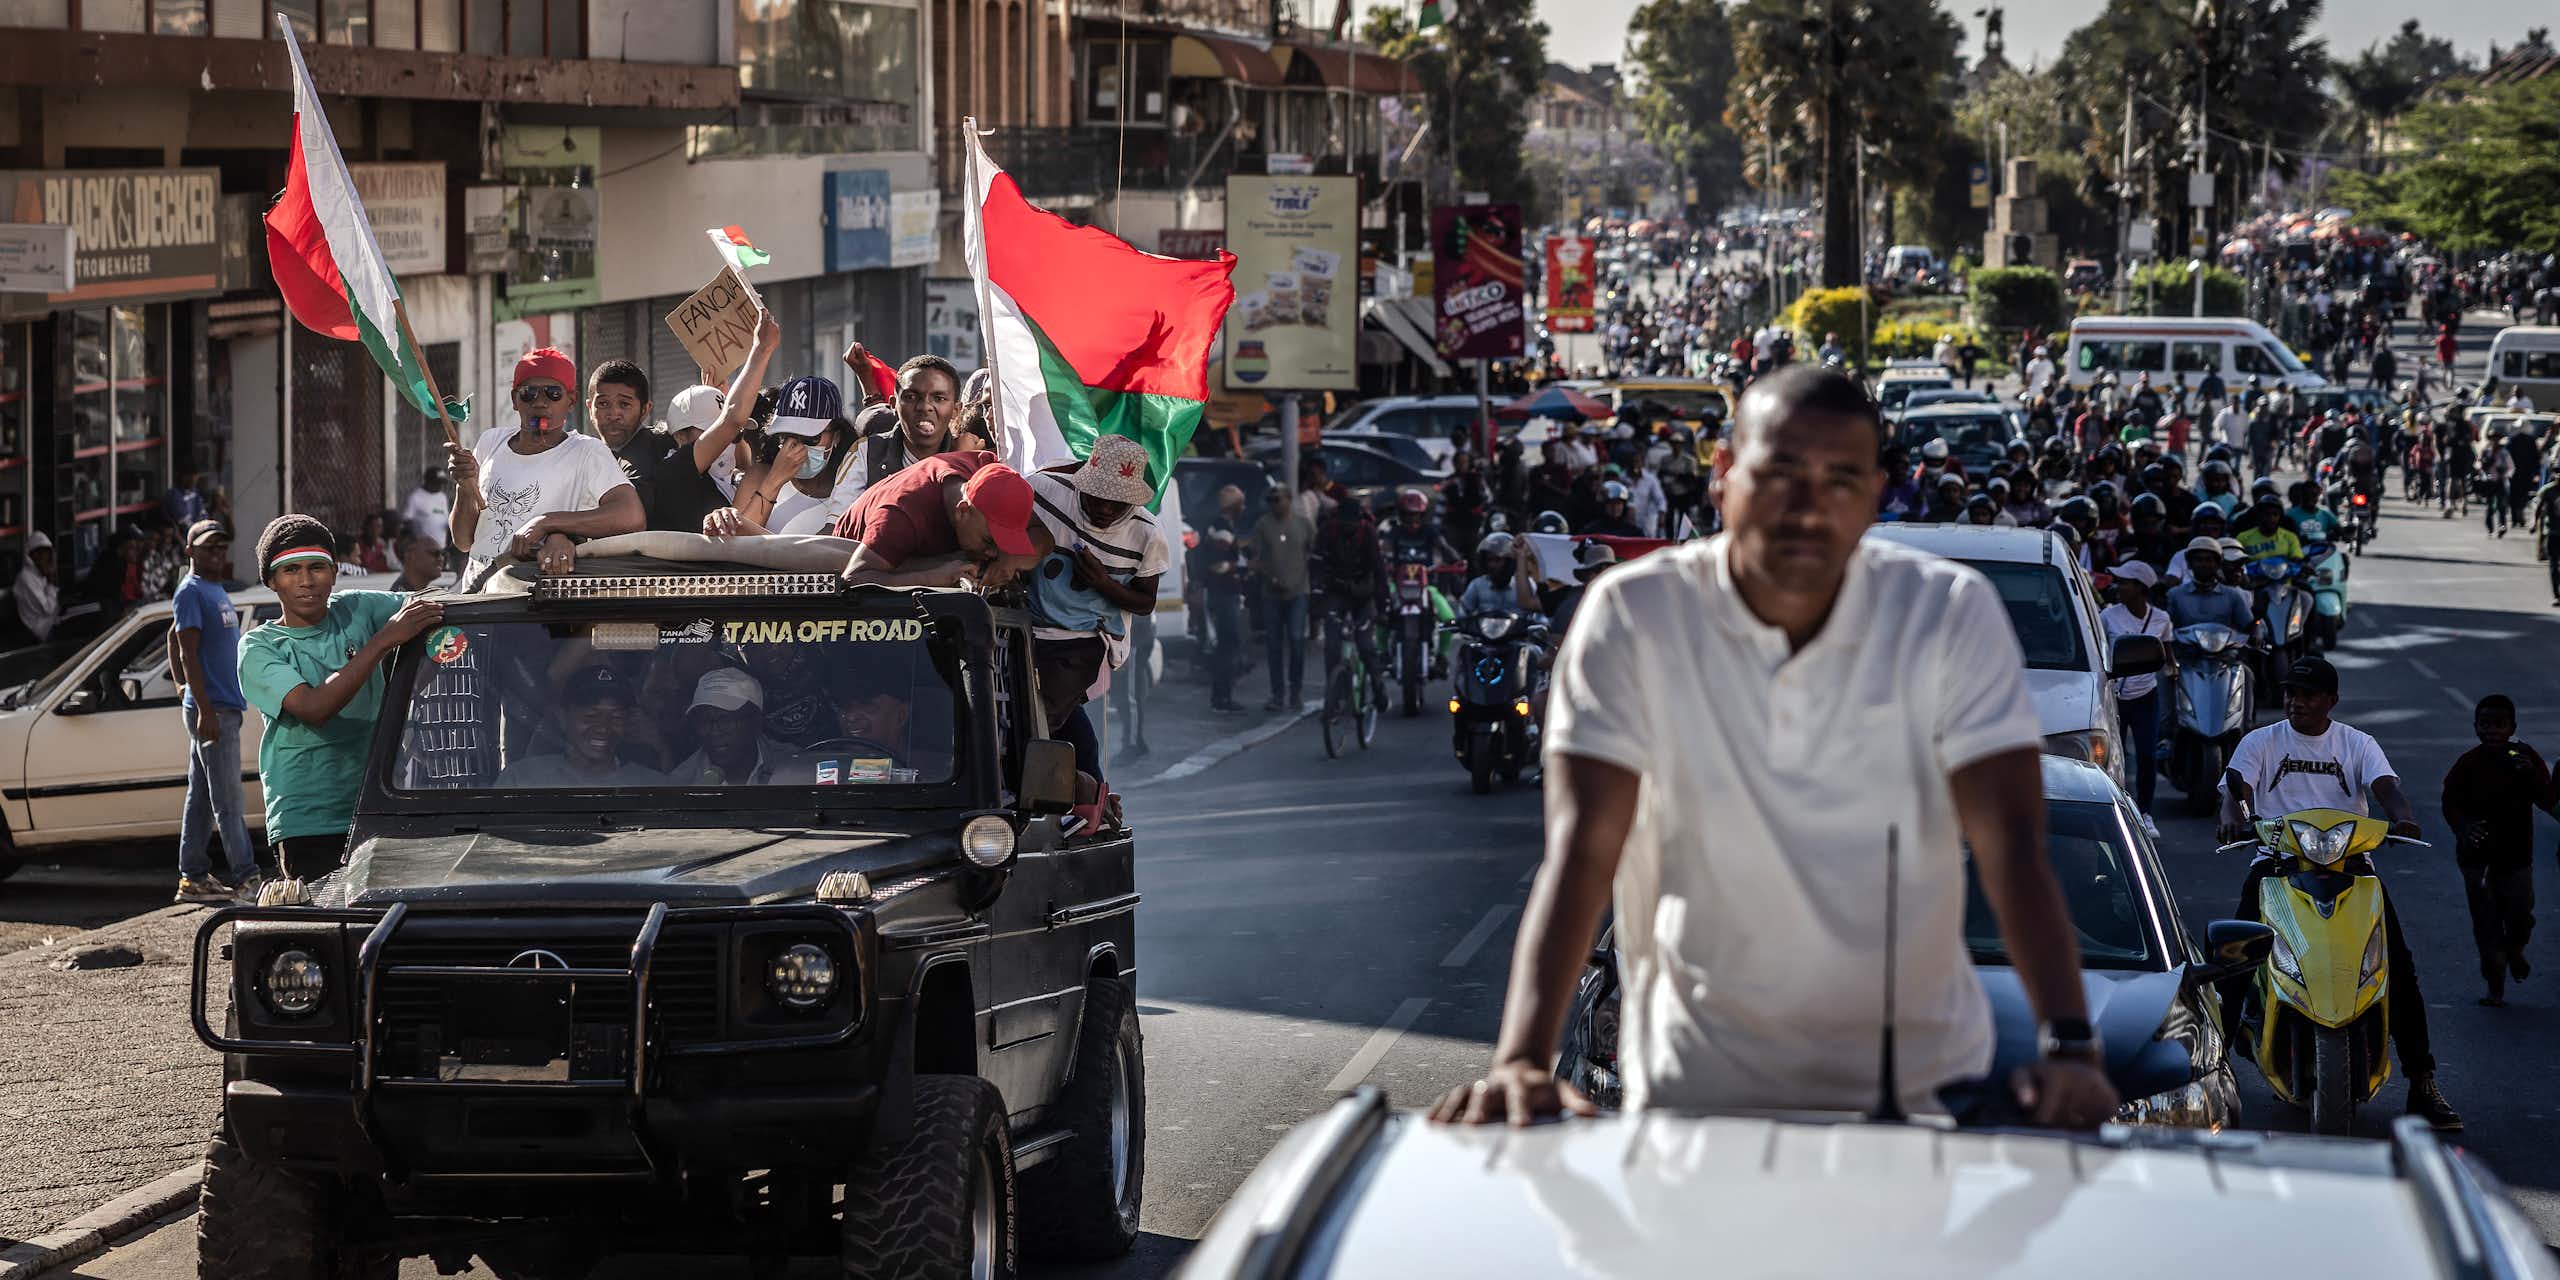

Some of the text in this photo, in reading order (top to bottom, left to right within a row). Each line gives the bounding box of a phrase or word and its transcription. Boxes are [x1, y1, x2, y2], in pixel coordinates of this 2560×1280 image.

[45, 174, 215, 251] BLACK&DECKER
[75, 253, 151, 279] TROMENAGER
[723, 618, 923, 644] TANA OFF ROAD
